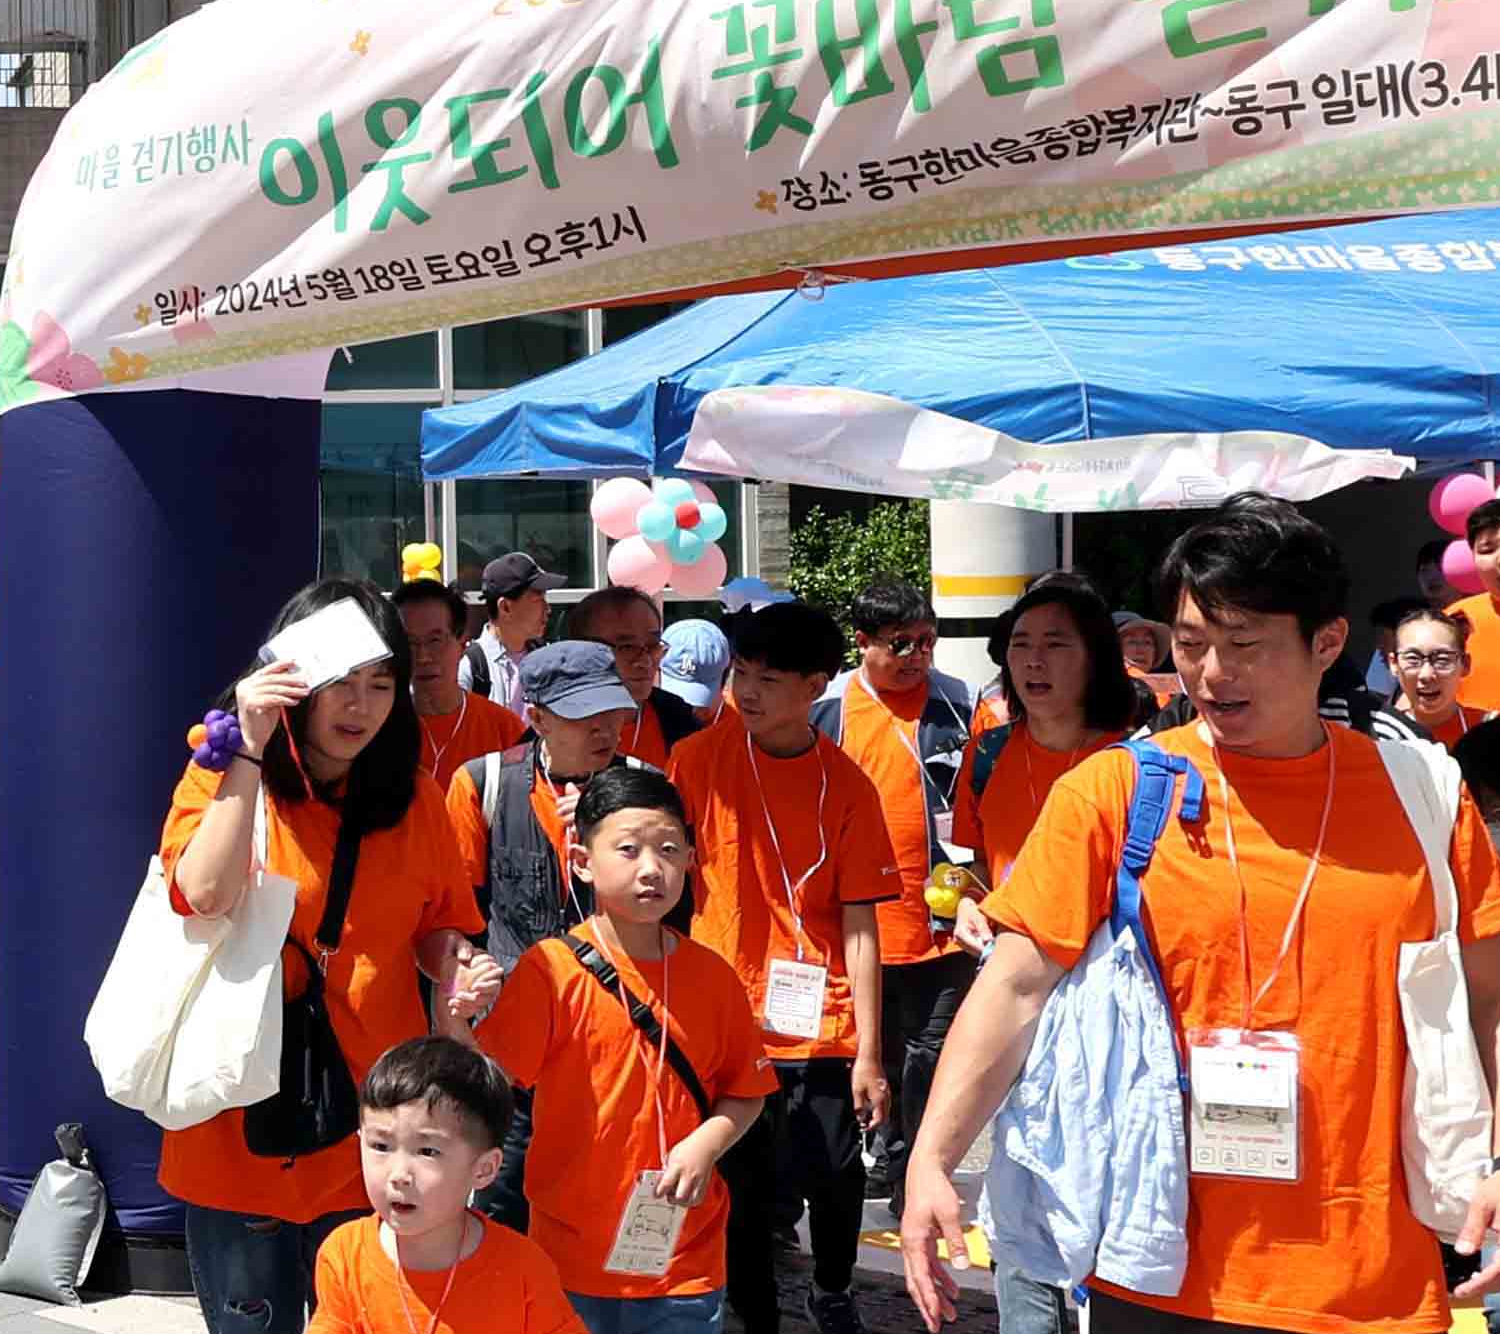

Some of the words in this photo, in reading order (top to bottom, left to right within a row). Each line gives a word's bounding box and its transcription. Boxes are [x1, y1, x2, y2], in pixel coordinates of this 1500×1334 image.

[131, 118, 253, 184] 걷기행사
[259, 31, 680, 233] 이웃되어
[781, 169, 852, 212] 장소:
[858, 75, 1314, 202] 동구한마음종합복지관~동구
[154, 285, 207, 327] 일시:
[214, 273, 306, 317] 2024년
[305, 267, 358, 301] 5월
[361, 258, 424, 295] 18일
[429, 239, 521, 286] 토요일
[524, 204, 647, 269] 오후1시
